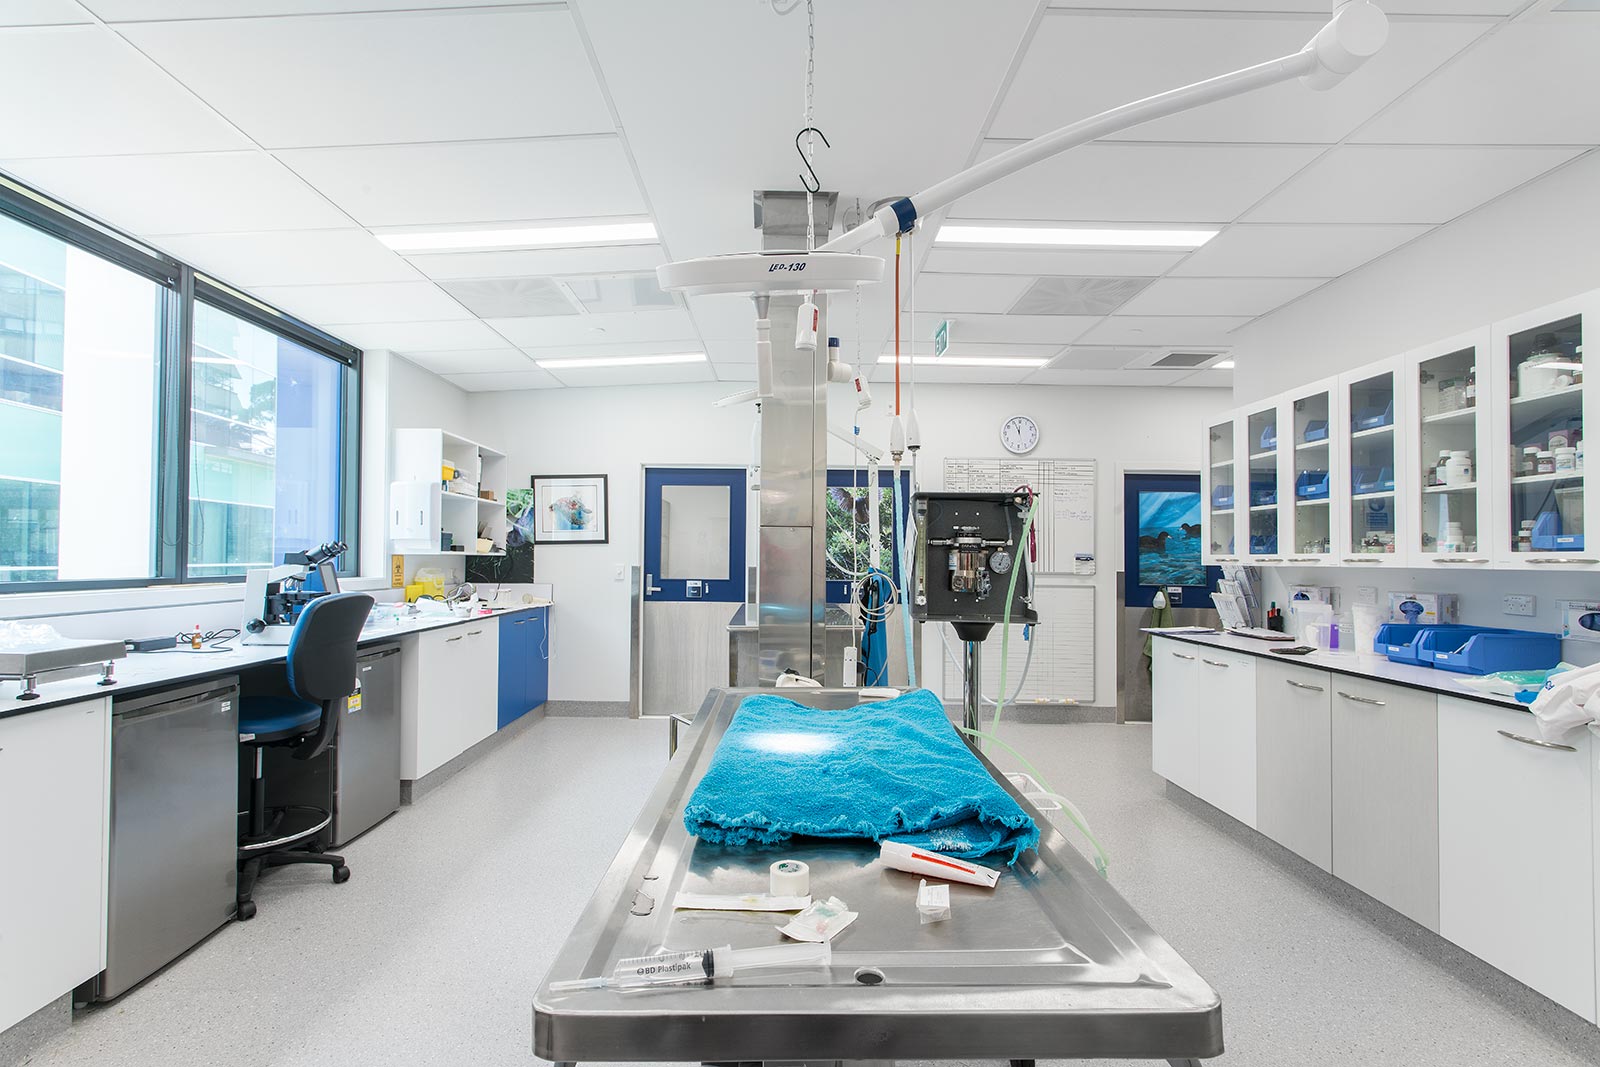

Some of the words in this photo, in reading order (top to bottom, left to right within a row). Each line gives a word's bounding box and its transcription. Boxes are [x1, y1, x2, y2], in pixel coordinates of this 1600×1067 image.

[768, 262, 807, 272] LED-130
[645, 967, 656, 975] BD
[657, 962, 691, 973] Plastipak
